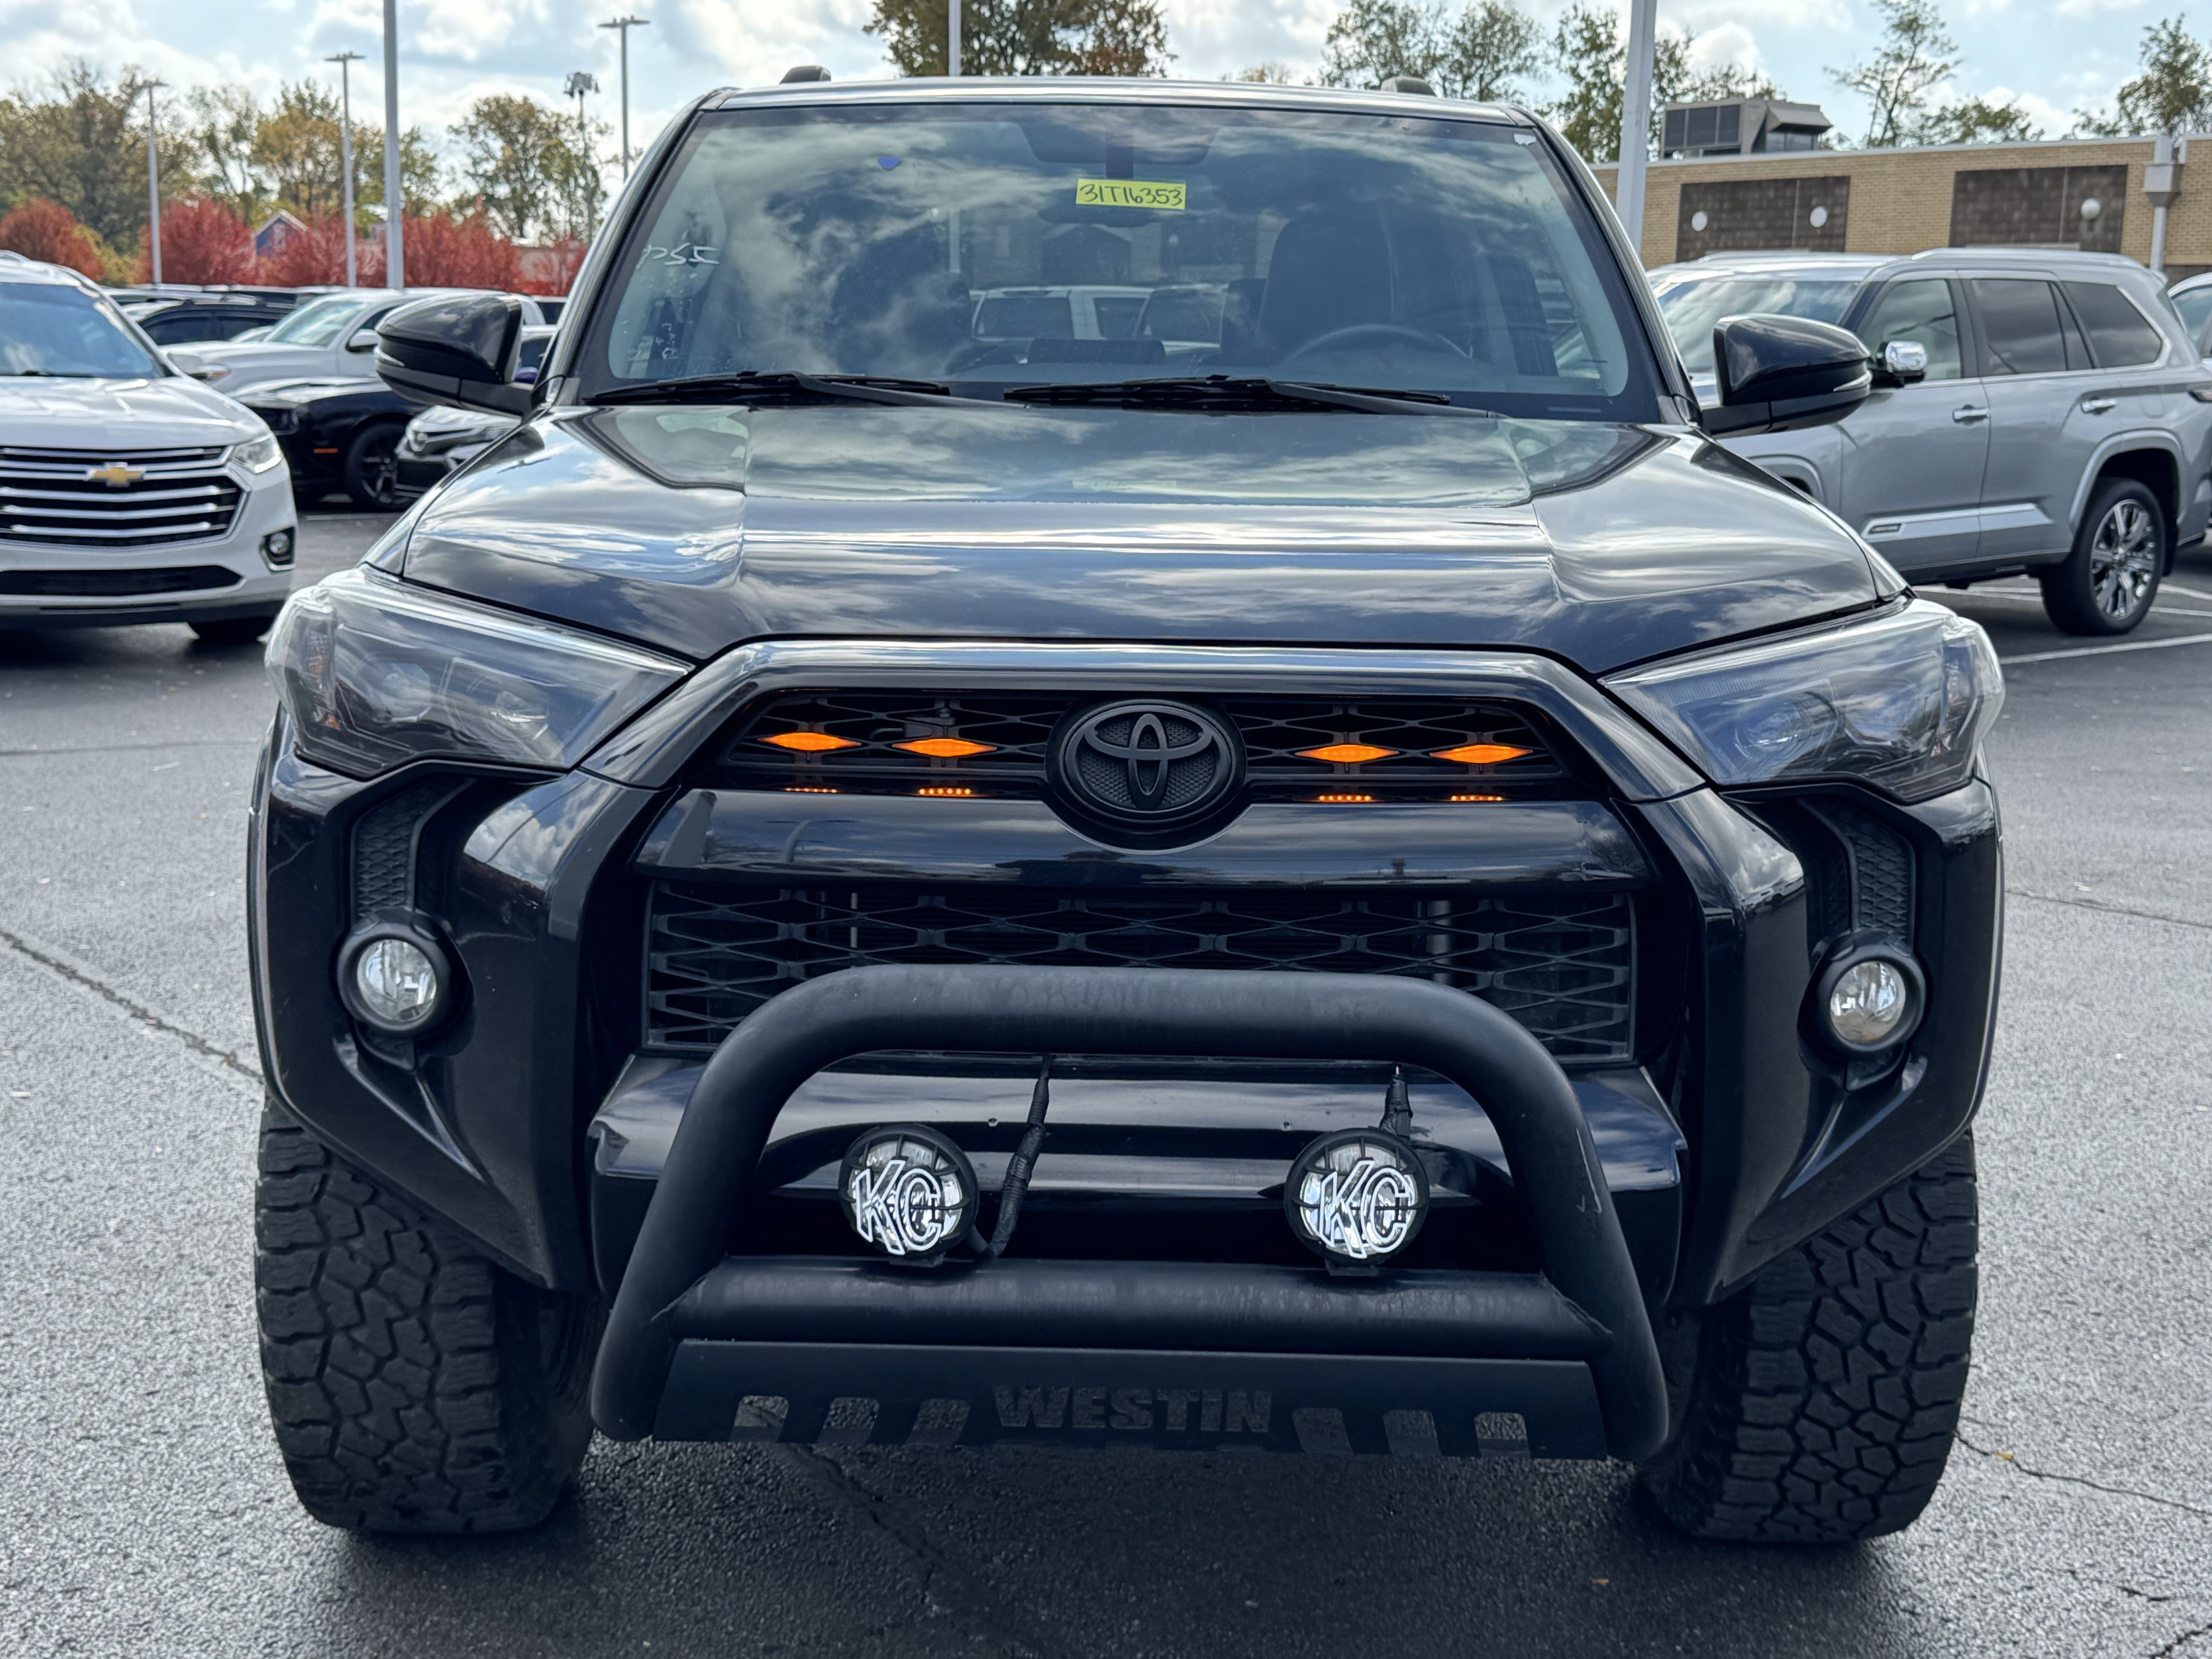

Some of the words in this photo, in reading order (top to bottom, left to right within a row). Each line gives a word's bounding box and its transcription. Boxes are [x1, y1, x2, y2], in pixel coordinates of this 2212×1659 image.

[1080, 184, 1183, 206] 31T16353
[855, 1159, 942, 1255] KC
[1319, 1160, 1409, 1259] KC
[993, 1386, 1272, 1432] WESTIN
